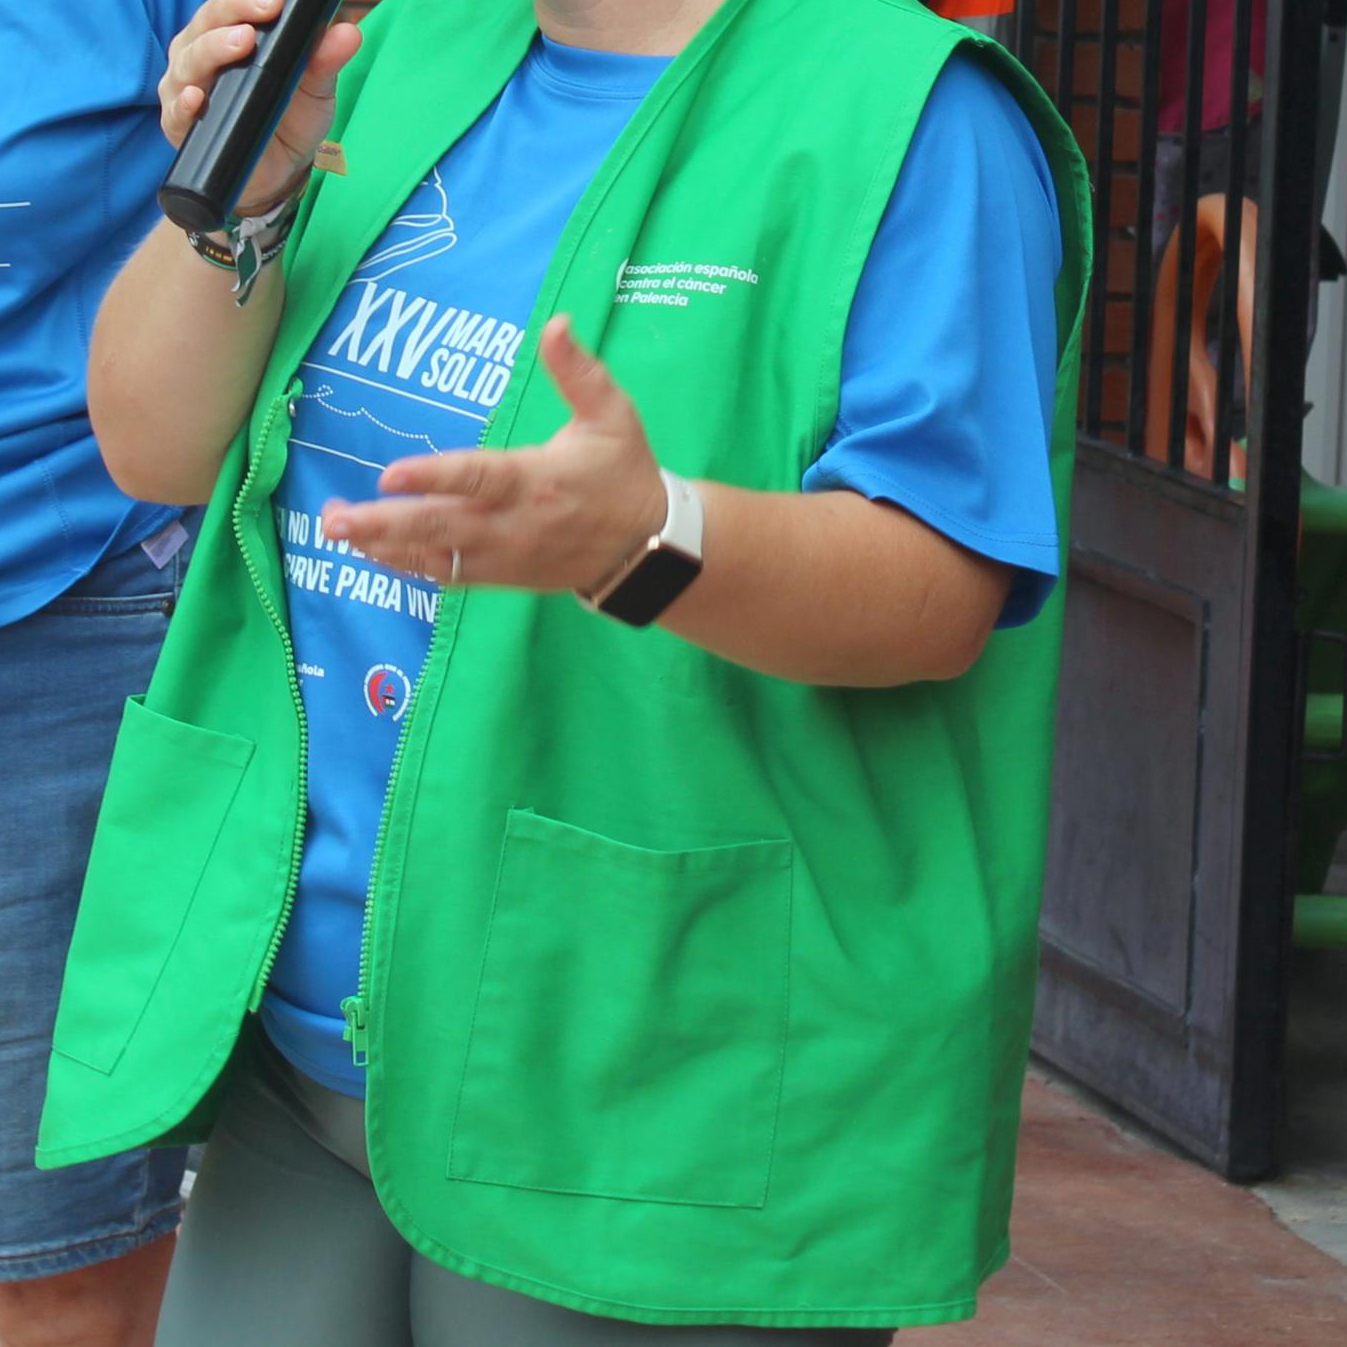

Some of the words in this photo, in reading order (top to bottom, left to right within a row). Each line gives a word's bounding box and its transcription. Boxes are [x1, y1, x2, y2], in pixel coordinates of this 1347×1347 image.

[619, 276, 659, 289] contra
[662, 276, 675, 289] el
[676, 277, 727, 295] cáncer
[625, 260, 692, 275] asociación
[694, 263, 759, 284] española
[630, 291, 689, 306] Palencia
[328, 280, 457, 380] XXV
[421, 347, 512, 408] SOLID
[288, 509, 310, 546] NO
[335, 564, 402, 613] PARA
